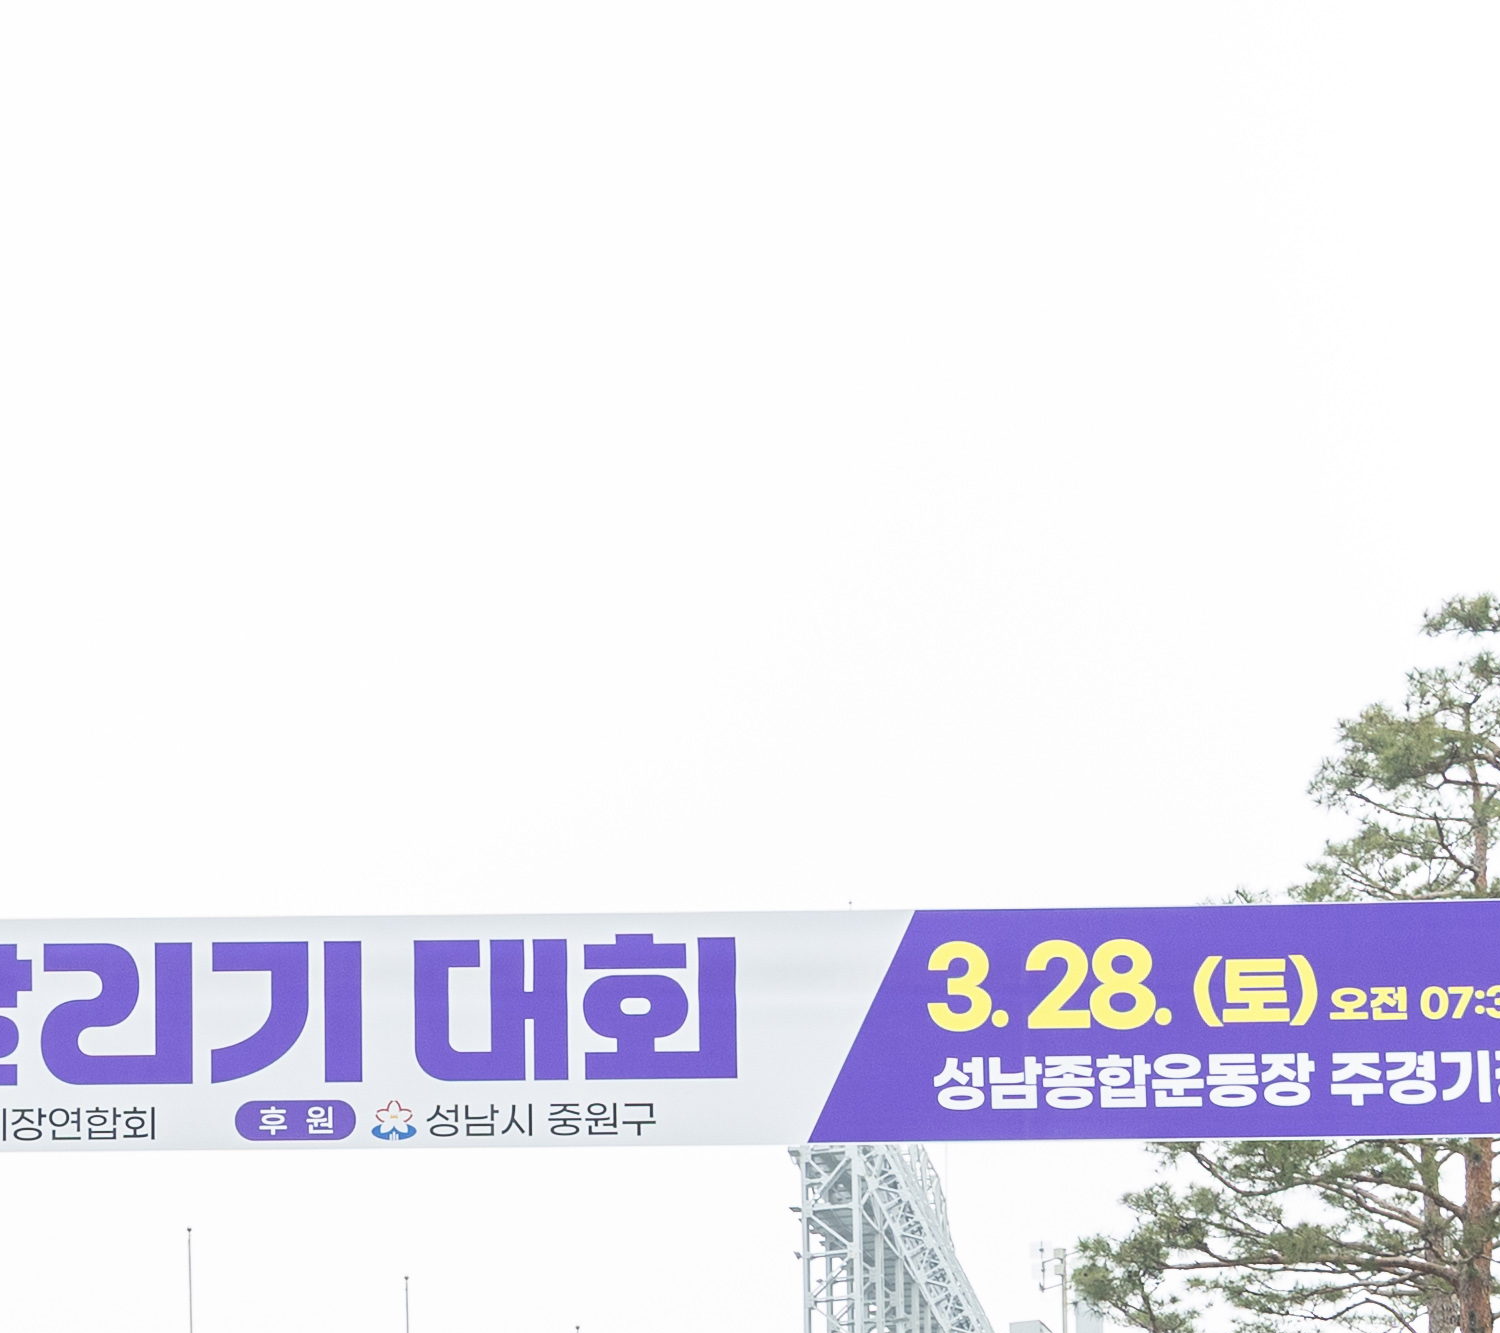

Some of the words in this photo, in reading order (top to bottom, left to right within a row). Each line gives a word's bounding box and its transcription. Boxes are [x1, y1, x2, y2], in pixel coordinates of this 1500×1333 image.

[413, 934, 738, 1081] 대회
[928, 940, 1009, 1032] 3.
[1026, 939, 1173, 1030] 28.
[1194, 955, 1318, 1027] (토)
[1330, 987, 1408, 1021] 오전
[934, 1053, 1315, 1111] 성남종합운동장
[426, 1103, 533, 1138] 성남시
[547, 1102, 657, 1137] 중원구
